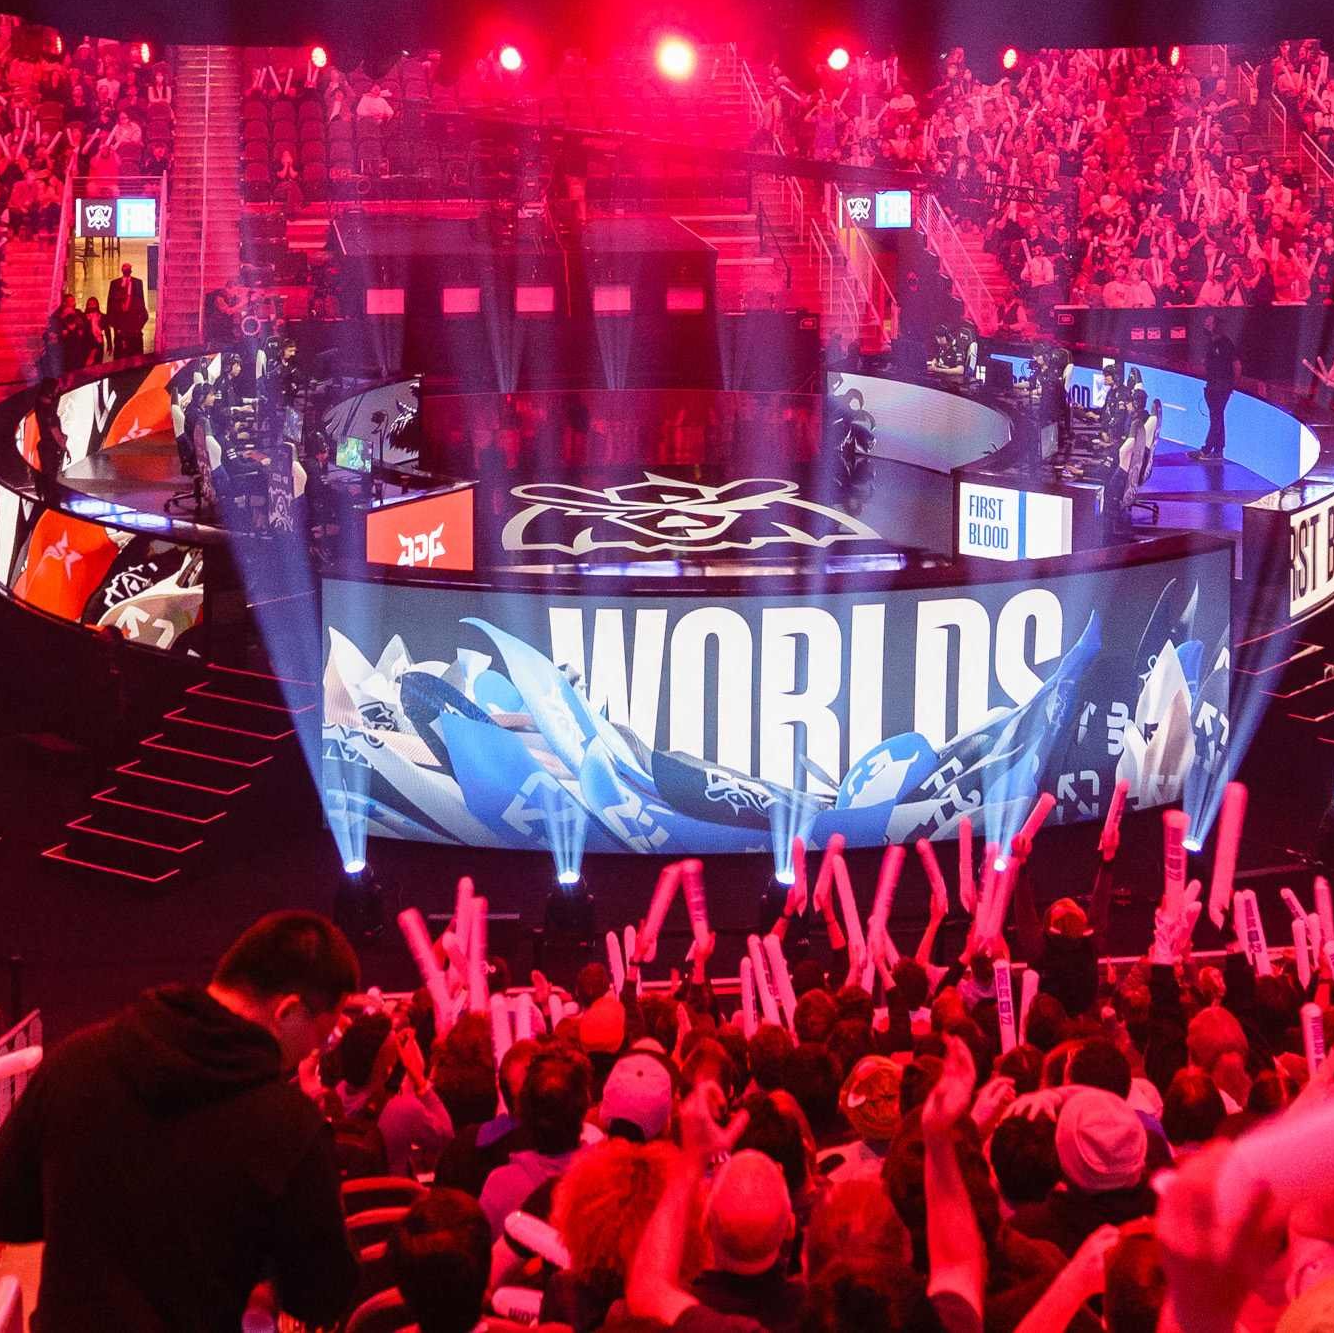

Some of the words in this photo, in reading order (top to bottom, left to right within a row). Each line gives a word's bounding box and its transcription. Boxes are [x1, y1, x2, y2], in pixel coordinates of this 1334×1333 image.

[969, 494, 1004, 522] FIRST
[968, 522, 1009, 550] BLOOD
[548, 587, 1065, 798] WORLDS
